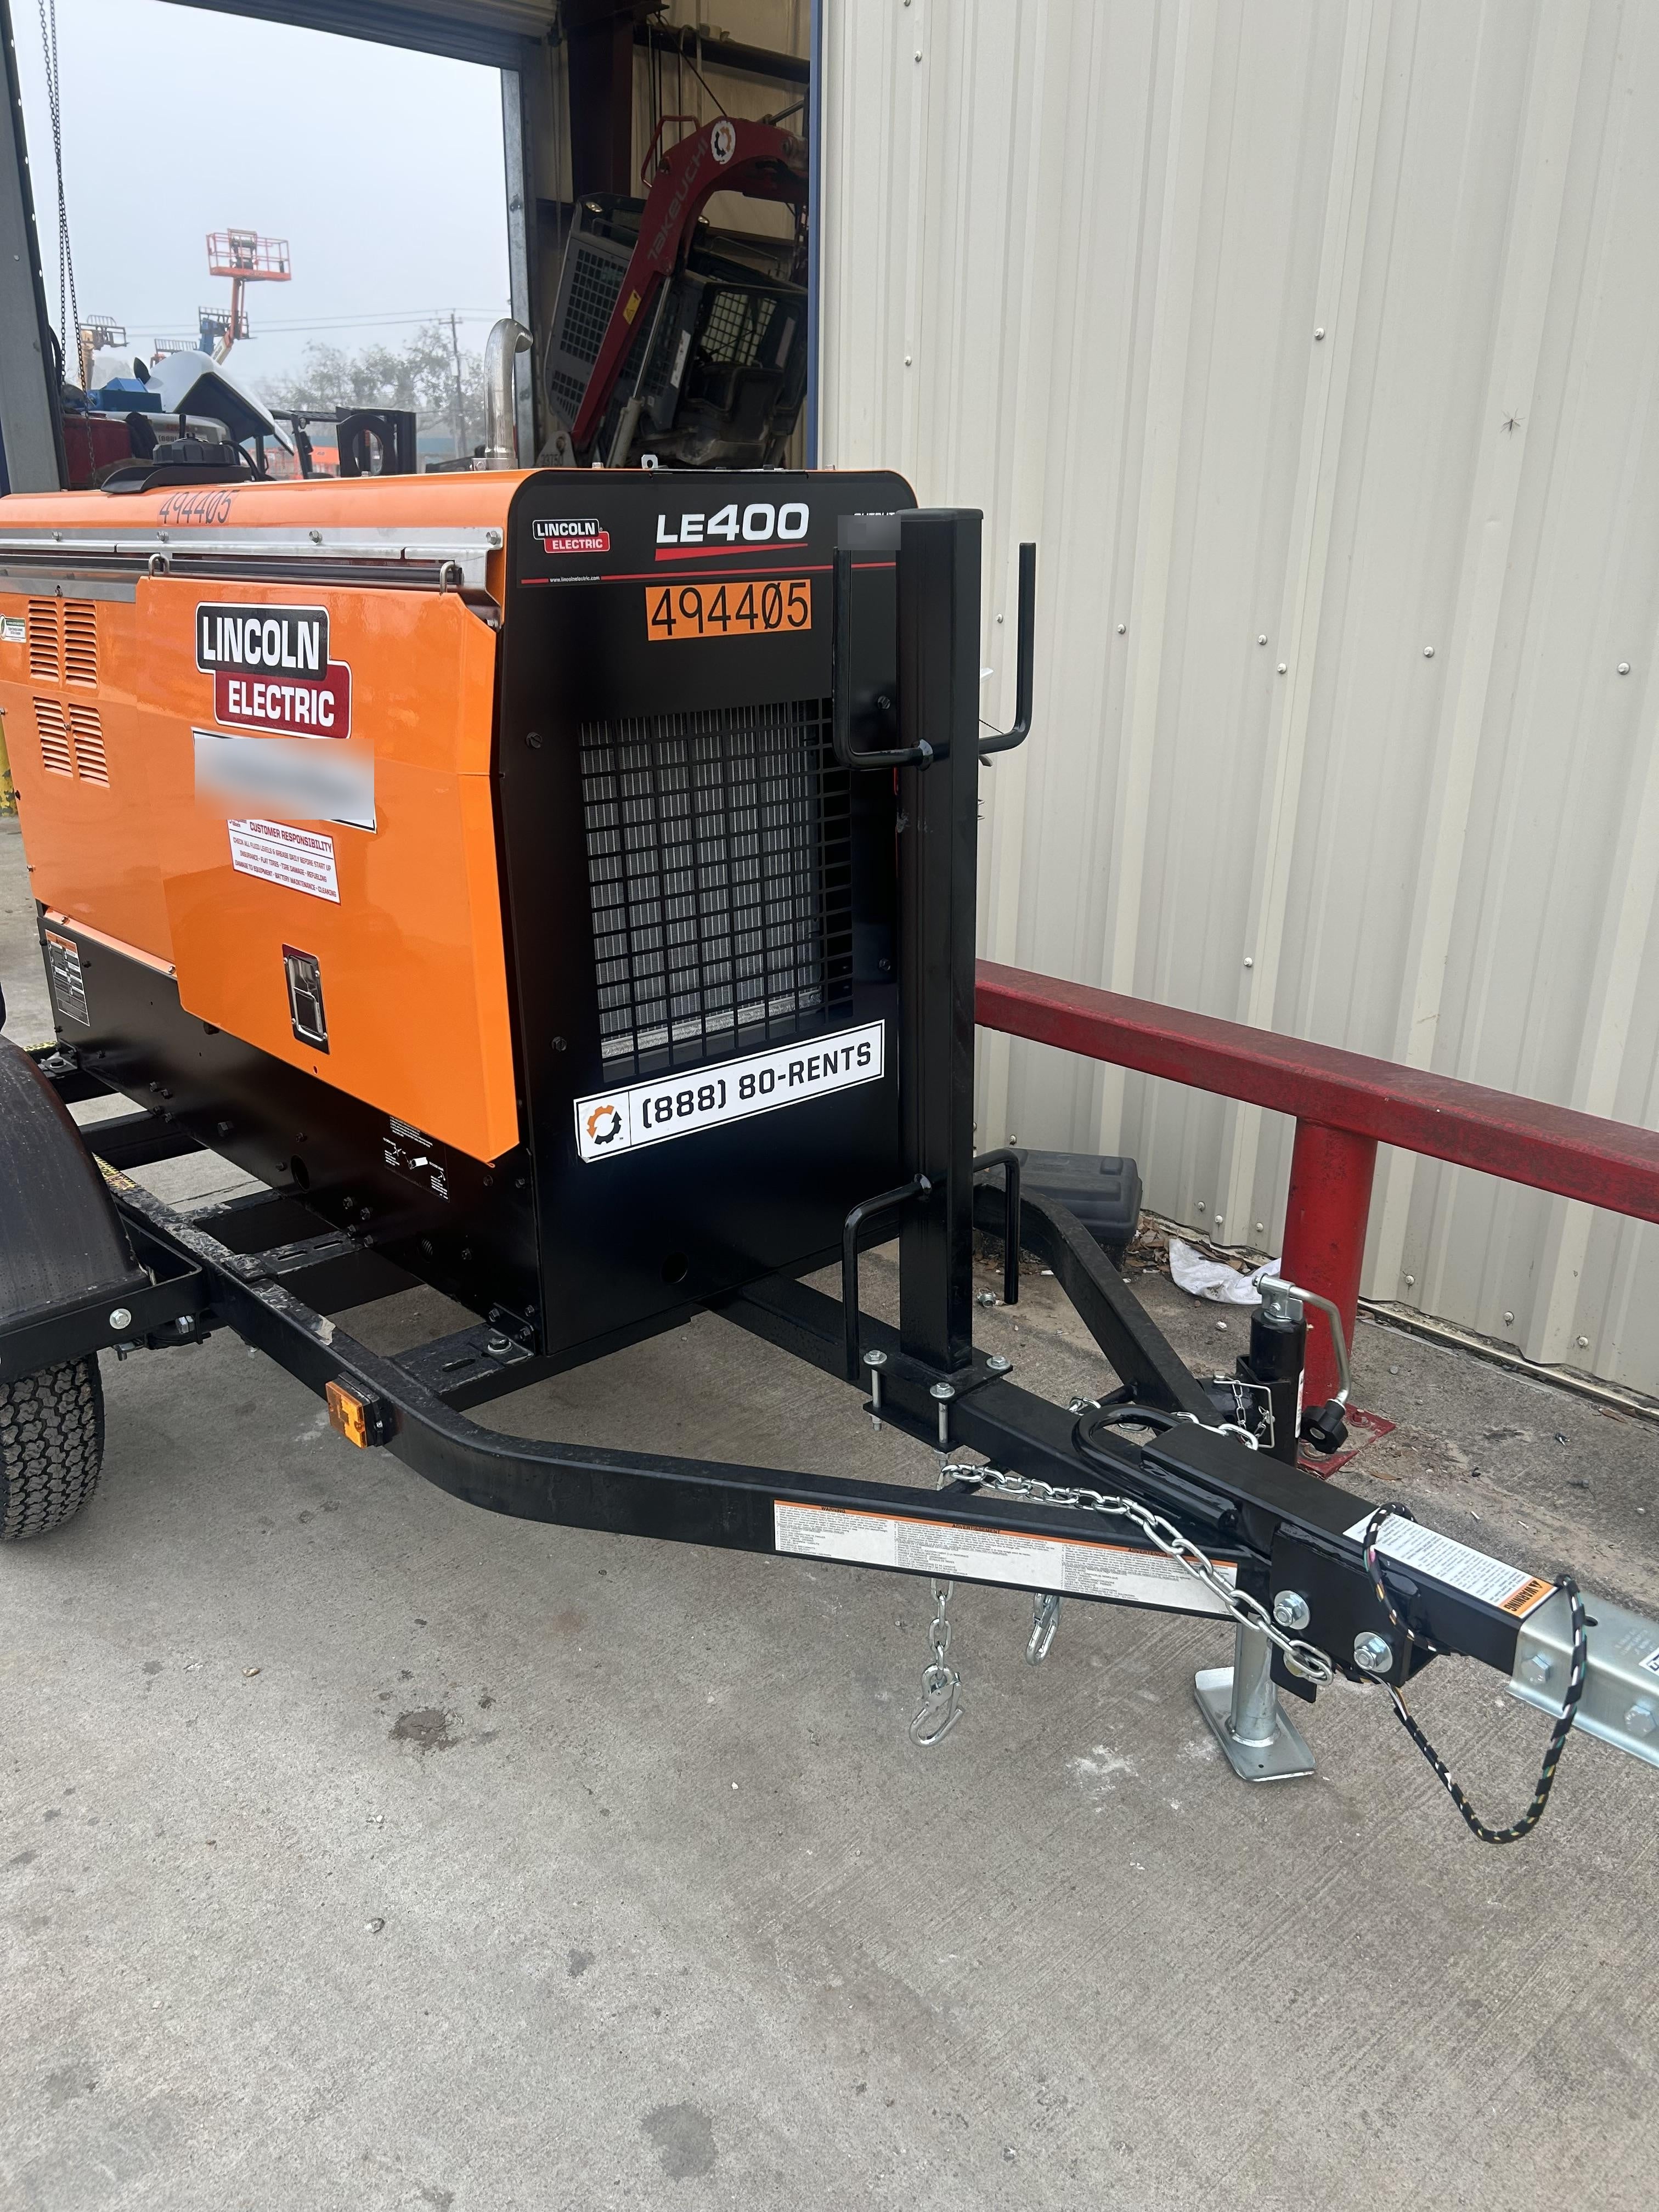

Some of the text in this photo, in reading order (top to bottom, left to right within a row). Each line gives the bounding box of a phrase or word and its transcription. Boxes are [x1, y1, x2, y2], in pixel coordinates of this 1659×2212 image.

[159, 489, 241, 524] 494405
[656, 503, 809, 543] LE400
[537, 522, 595, 537] LINCOLN
[552, 539, 603, 550] ELECTRIC
[651, 582, 808, 636] 494405
[203, 616, 319, 670] LINCOLN
[229, 680, 335, 727] ELECTRIC
[233, 837, 244, 845] CHECK
[314, 861, 325, 870] START
[250, 821, 281, 839] CUSTOMER
[281, 830, 332, 853] RESPONSIBILITY
[643, 1041, 871, 1128] (888) 80-RENTS
[1504, 1586, 1539, 1612] WARNING
